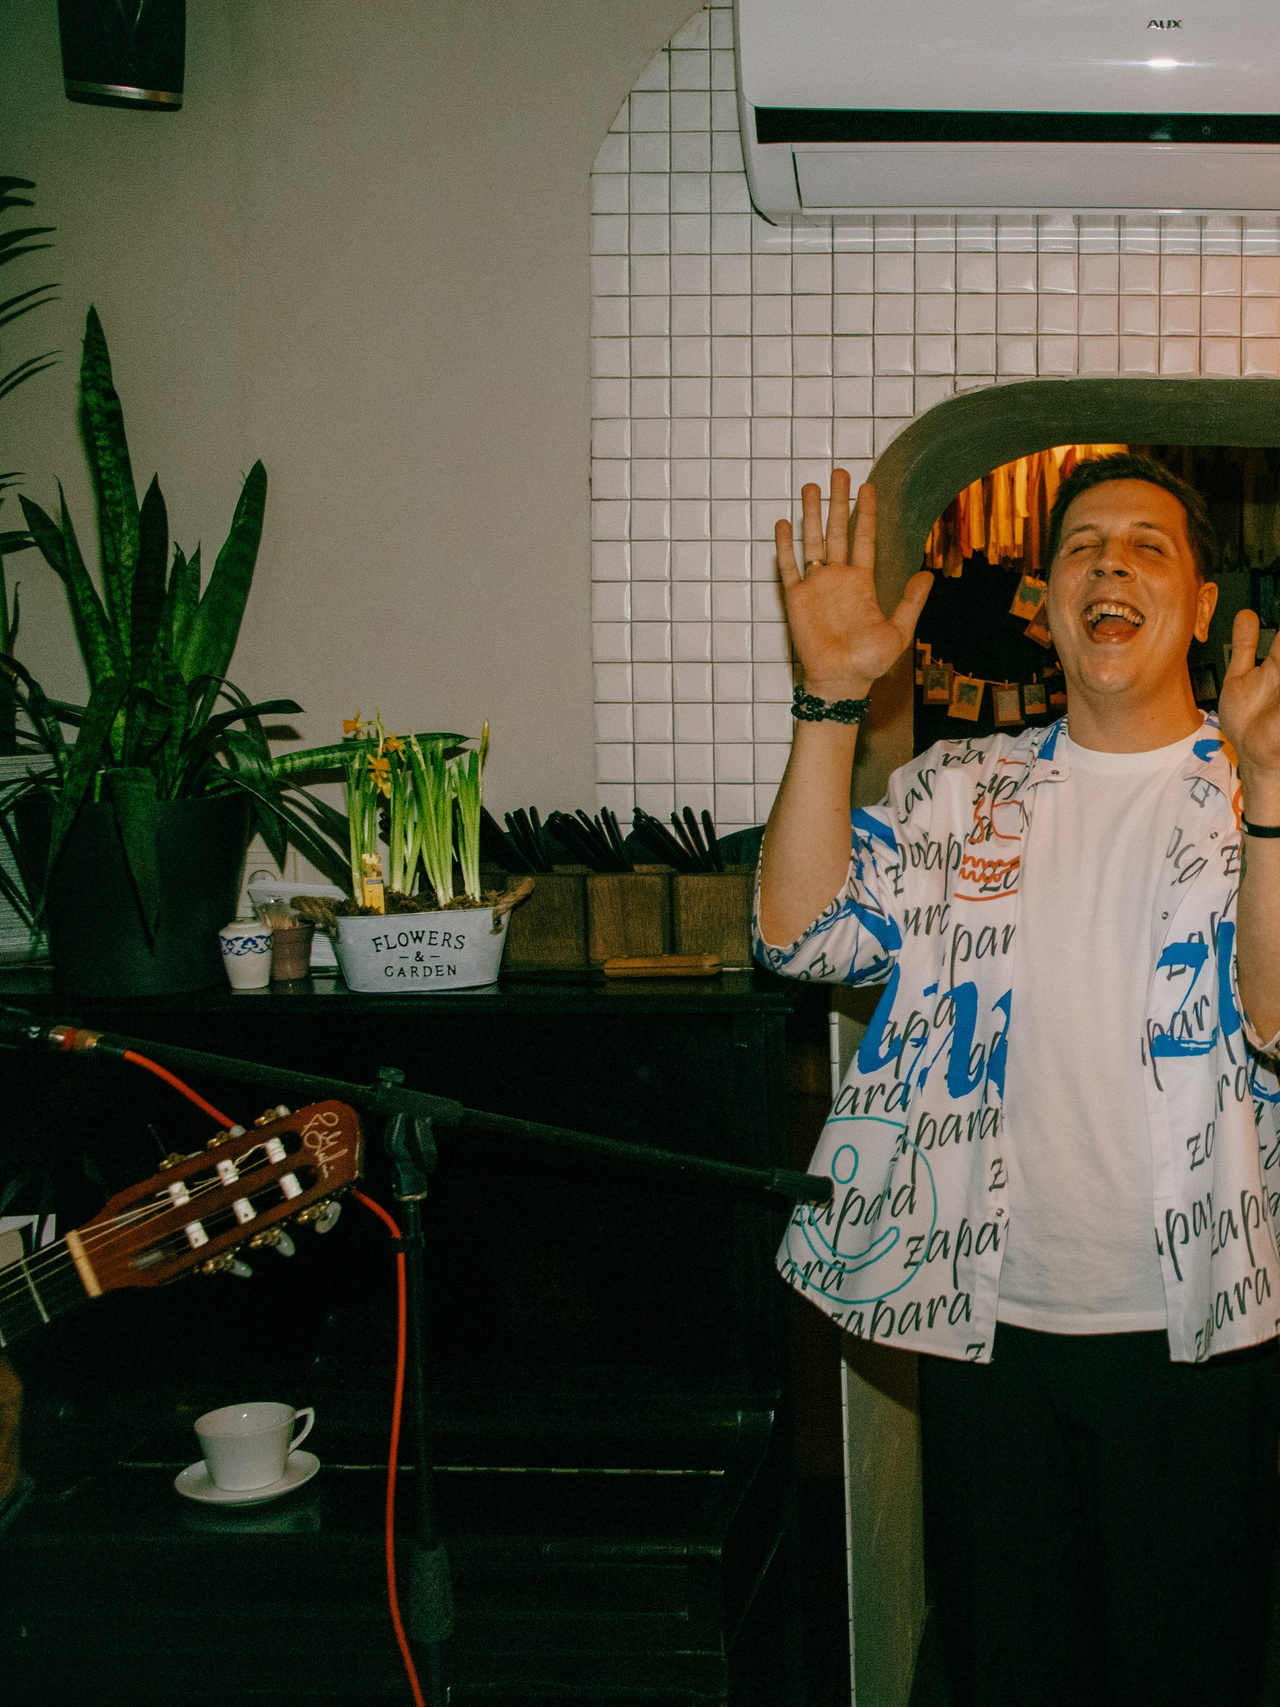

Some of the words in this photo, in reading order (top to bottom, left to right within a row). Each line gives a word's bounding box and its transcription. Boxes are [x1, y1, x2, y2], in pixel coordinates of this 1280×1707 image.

[1146, 19, 1183, 30] AUX
[371, 930, 466, 953] FLOWERS
[414, 950, 425, 962] &
[384, 964, 458, 978] GARDEN
